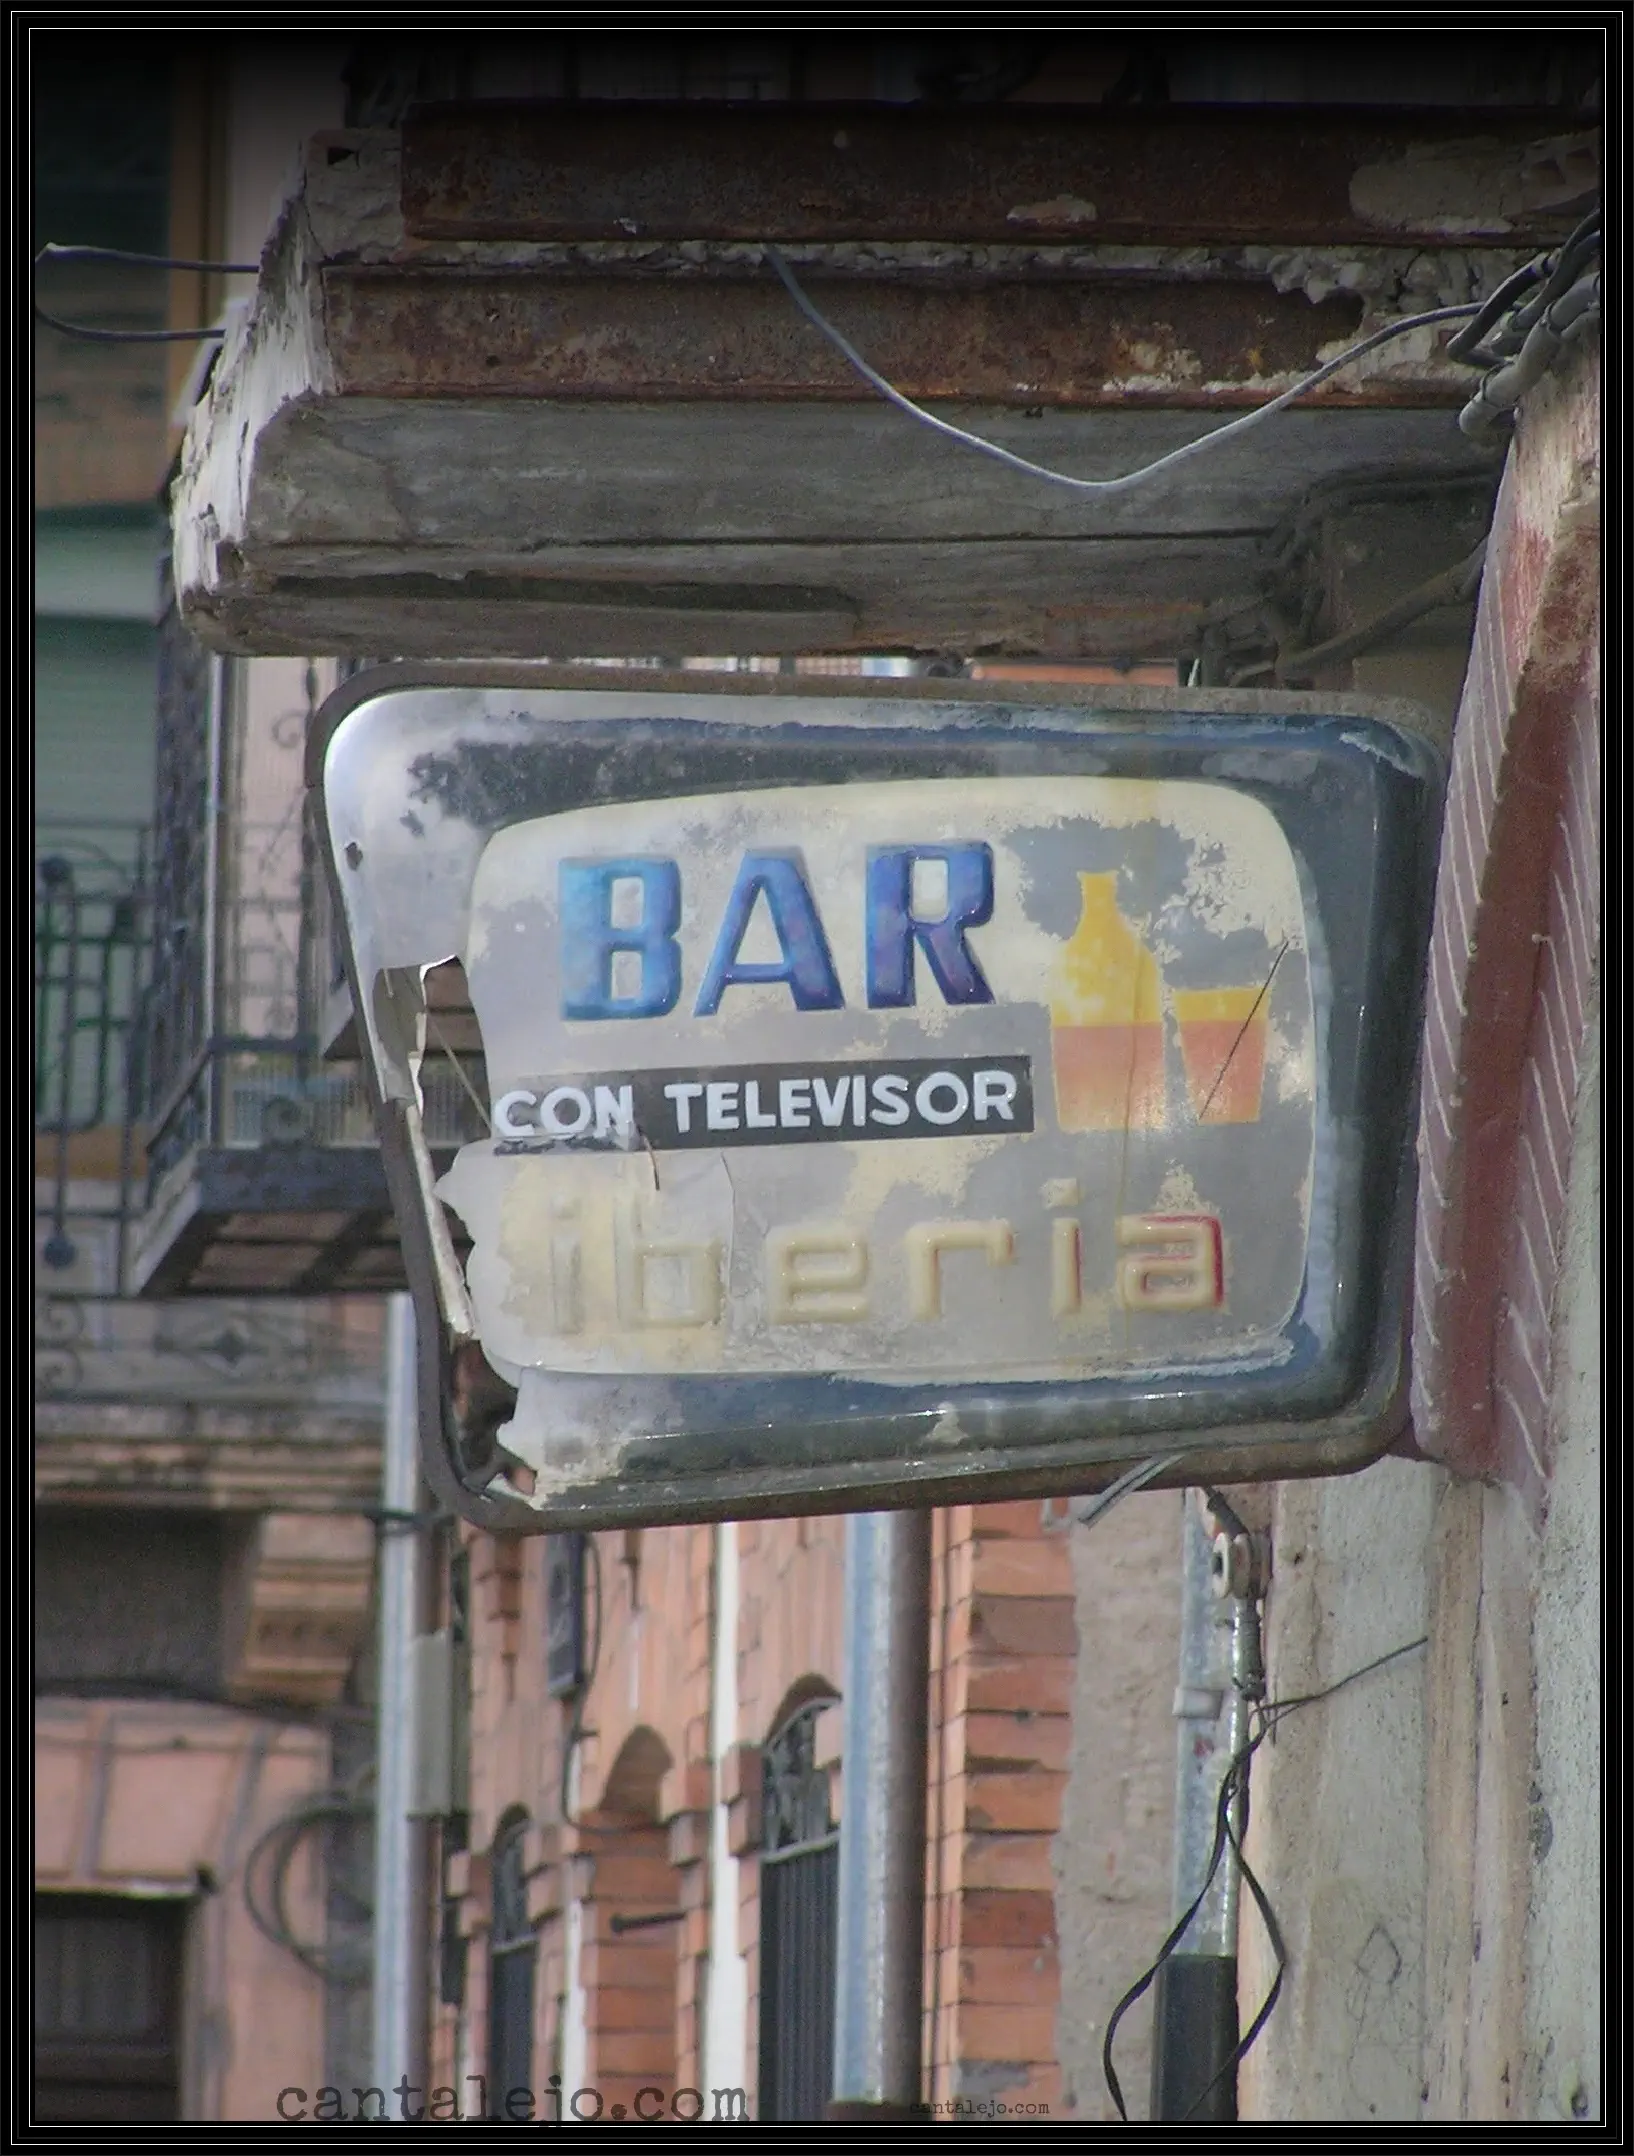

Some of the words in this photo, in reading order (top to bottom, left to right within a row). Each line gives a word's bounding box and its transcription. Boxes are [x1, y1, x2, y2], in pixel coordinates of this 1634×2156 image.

[559, 841, 996, 1020] BAR
[493, 1084, 634, 1141] CON
[664, 1071, 1018, 1134] TELEVISOR
[550, 1178, 1225, 1334] iberia
